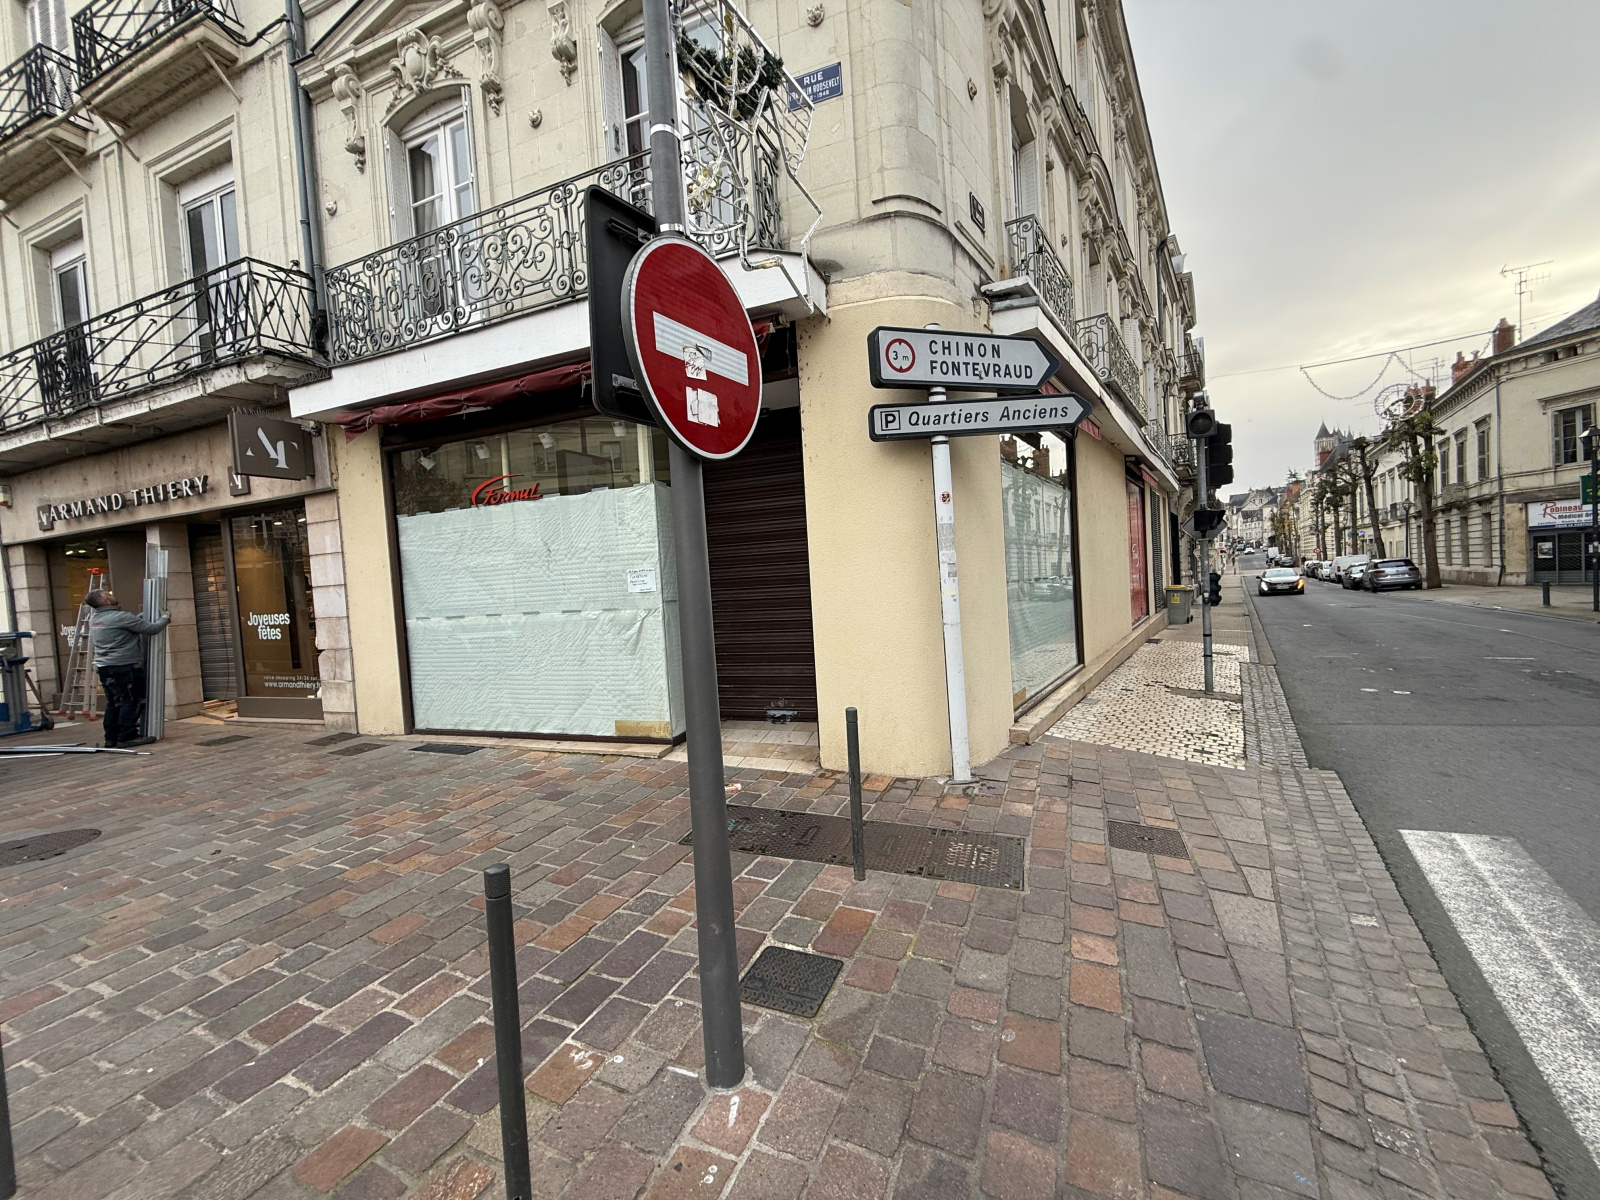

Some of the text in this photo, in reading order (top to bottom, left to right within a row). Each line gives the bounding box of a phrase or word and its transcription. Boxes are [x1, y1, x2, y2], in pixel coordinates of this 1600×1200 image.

[803, 71, 824, 86] RUE
[813, 76, 840, 93] ROOSEVELT
[892, 350, 899, 361] 3
[928, 339, 1001, 359] CHINON
[929, 360, 1033, 380] FONTEVRAUD
[884, 413, 897, 429] P
[908, 404, 1069, 427] Quartiers Anciens
[50, 475, 206, 521] ARMAND THIERY
[1540, 501, 1583, 520] Robineau
[247, 612, 290, 627] Joyeuses
[257, 625, 282, 640] fêtes
